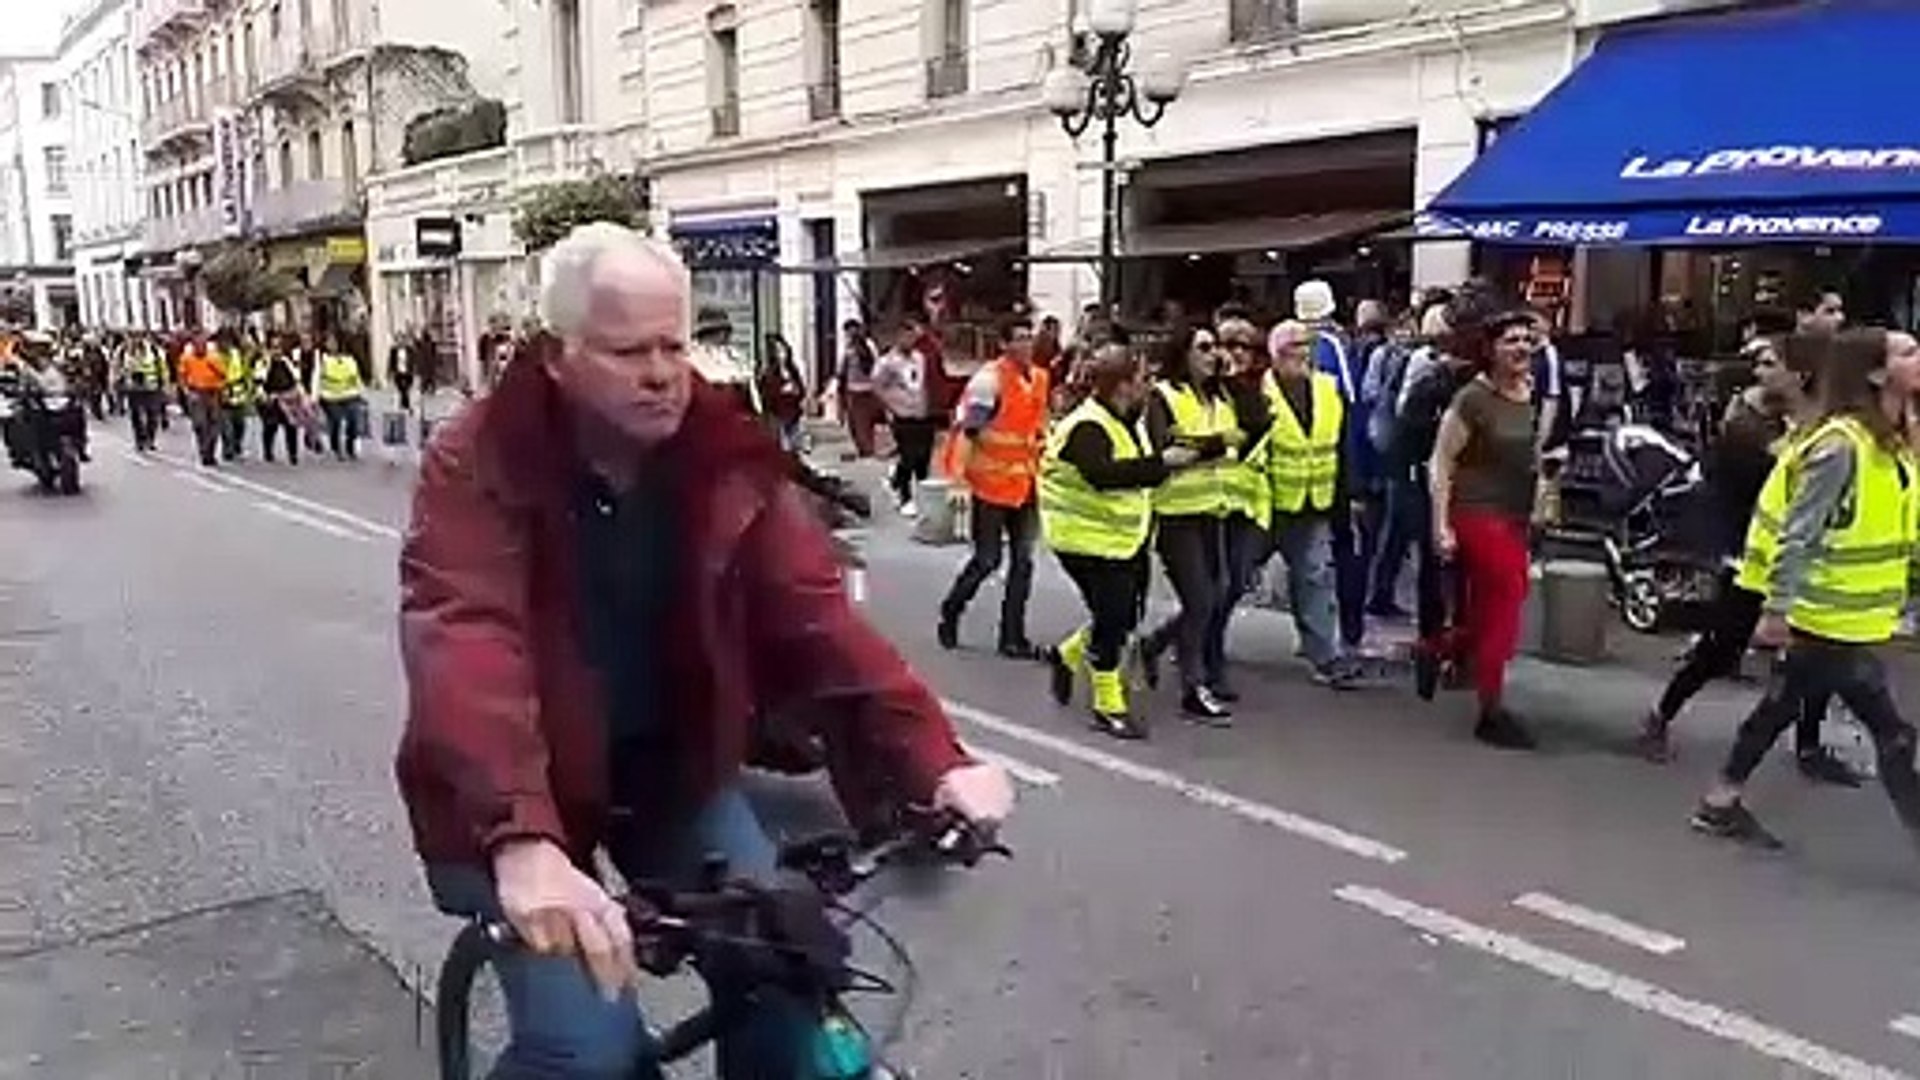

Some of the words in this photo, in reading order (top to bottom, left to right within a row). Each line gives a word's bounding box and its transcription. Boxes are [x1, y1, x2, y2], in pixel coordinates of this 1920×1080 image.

[1620, 156, 1692, 178] La
[1465, 221, 1521, 238] BAC
[1533, 221, 1629, 241] PRESSE
[1685, 216, 1726, 234] La
[1727, 214, 1882, 234] Provence
